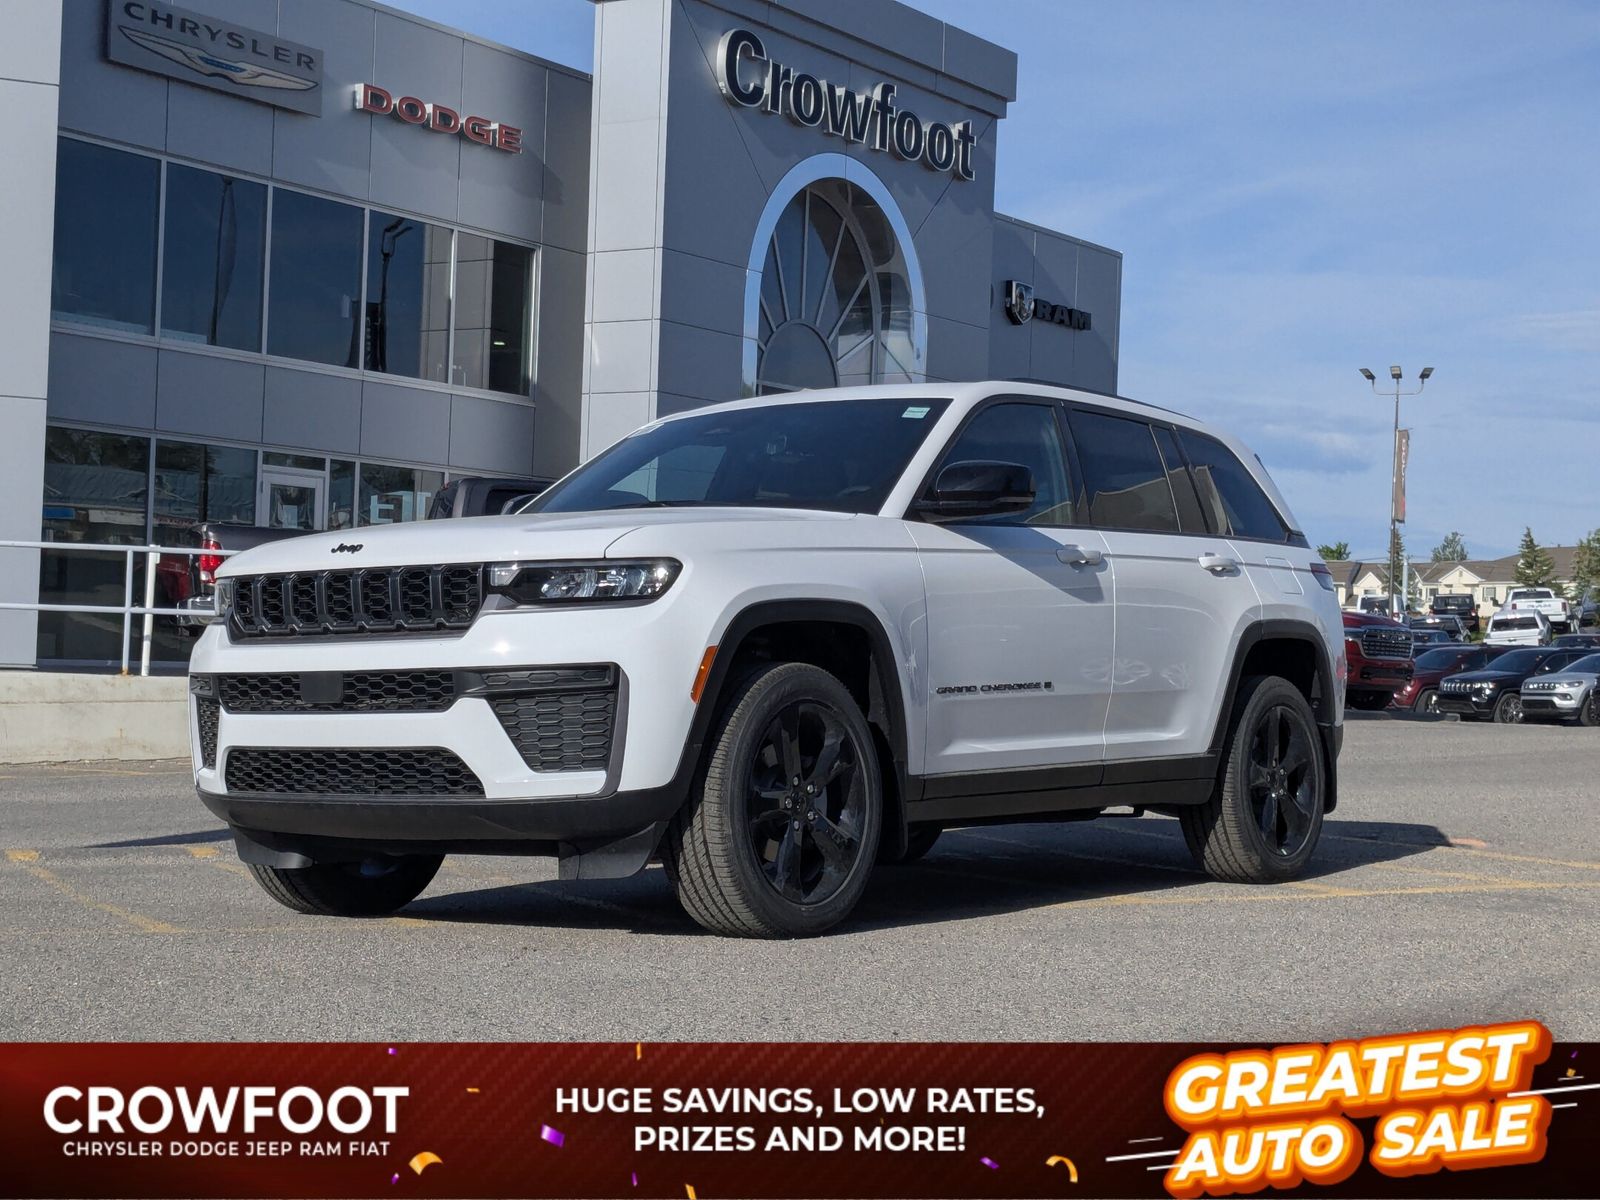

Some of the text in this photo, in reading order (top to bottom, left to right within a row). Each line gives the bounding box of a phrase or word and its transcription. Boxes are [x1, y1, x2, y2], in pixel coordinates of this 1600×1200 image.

[124, 0, 315, 71] CHRYSLER
[356, 82, 523, 155] DODGE
[717, 28, 977, 182] Crowfoot
[1034, 298, 1092, 331] RAM
[331, 543, 364, 554] Jeep
[936, 685, 978, 695] GRAND
[980, 681, 1042, 692] CHEROKEE
